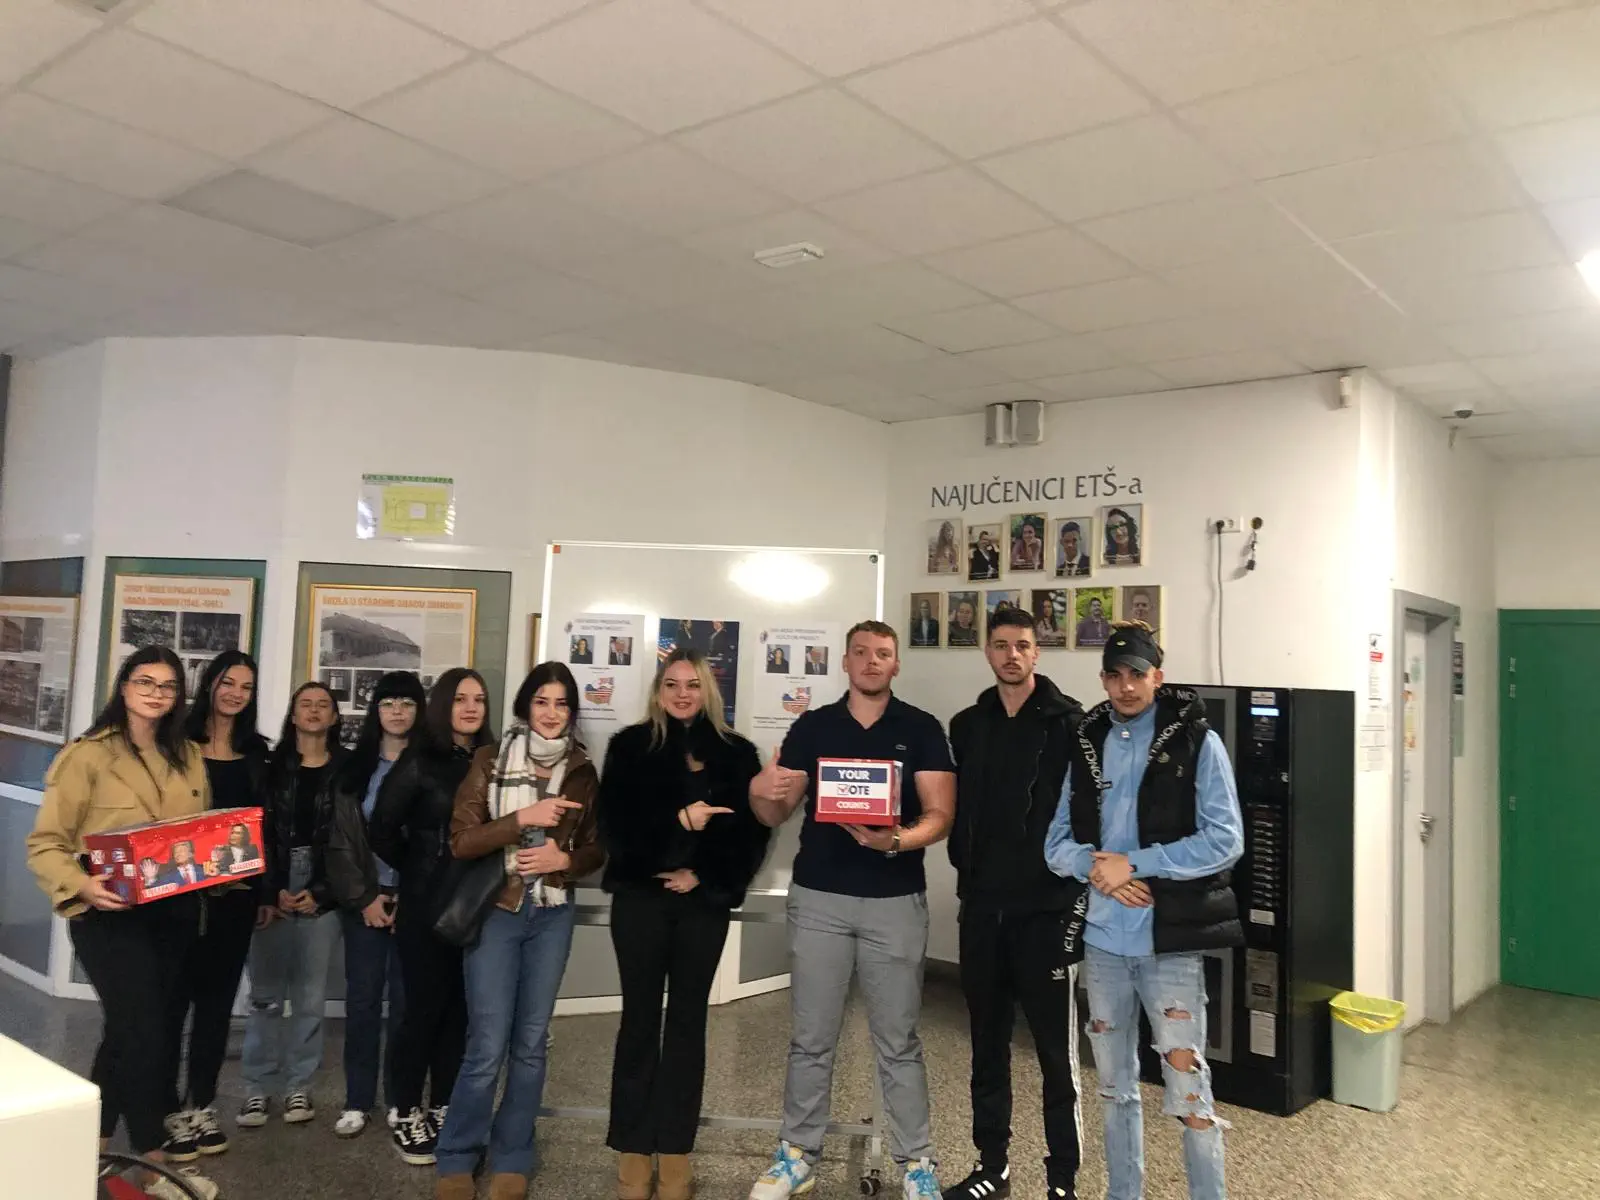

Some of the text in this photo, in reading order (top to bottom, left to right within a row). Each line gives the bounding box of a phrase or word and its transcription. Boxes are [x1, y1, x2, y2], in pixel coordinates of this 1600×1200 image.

[930, 465, 1143, 511] NAJUČENICI ETŠ-a
[837, 769, 870, 780] YOUR
[1079, 737, 1104, 789] MONCLER
